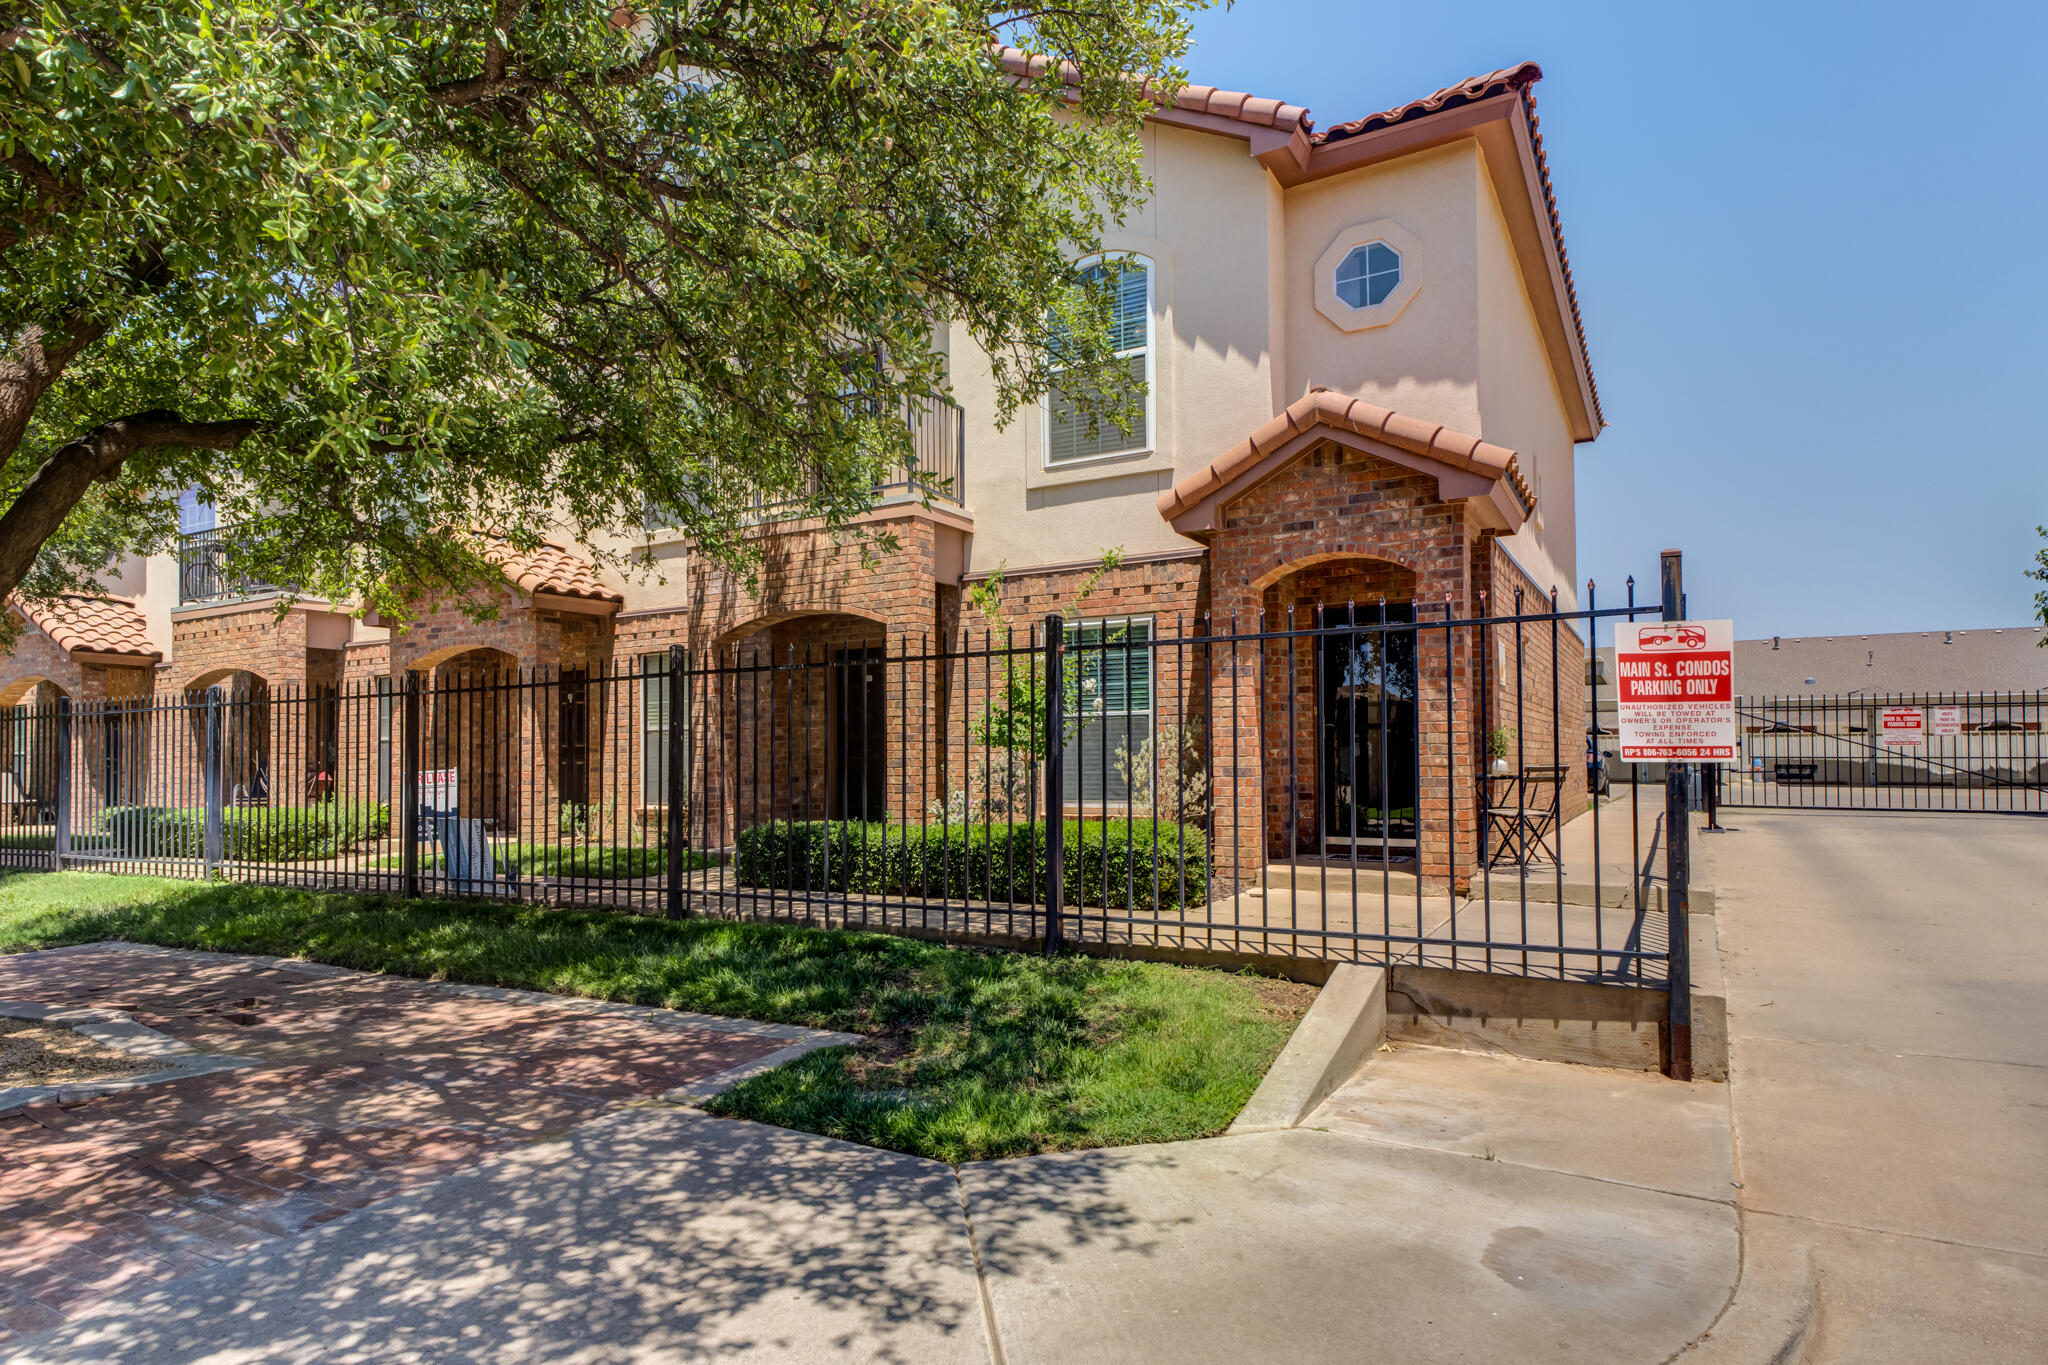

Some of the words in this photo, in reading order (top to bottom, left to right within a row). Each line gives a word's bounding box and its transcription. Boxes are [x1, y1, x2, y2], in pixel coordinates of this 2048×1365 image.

[1620, 661, 1650, 677] MAIN
[1654, 661, 1672, 677] St.
[1676, 660, 1729, 676] CONDOS
[1630, 679, 1682, 696] PARKING
[1686, 678, 1718, 695] ONLY
[1700, 748, 1711, 756] 24
[1713, 748, 1731, 756] HRS
